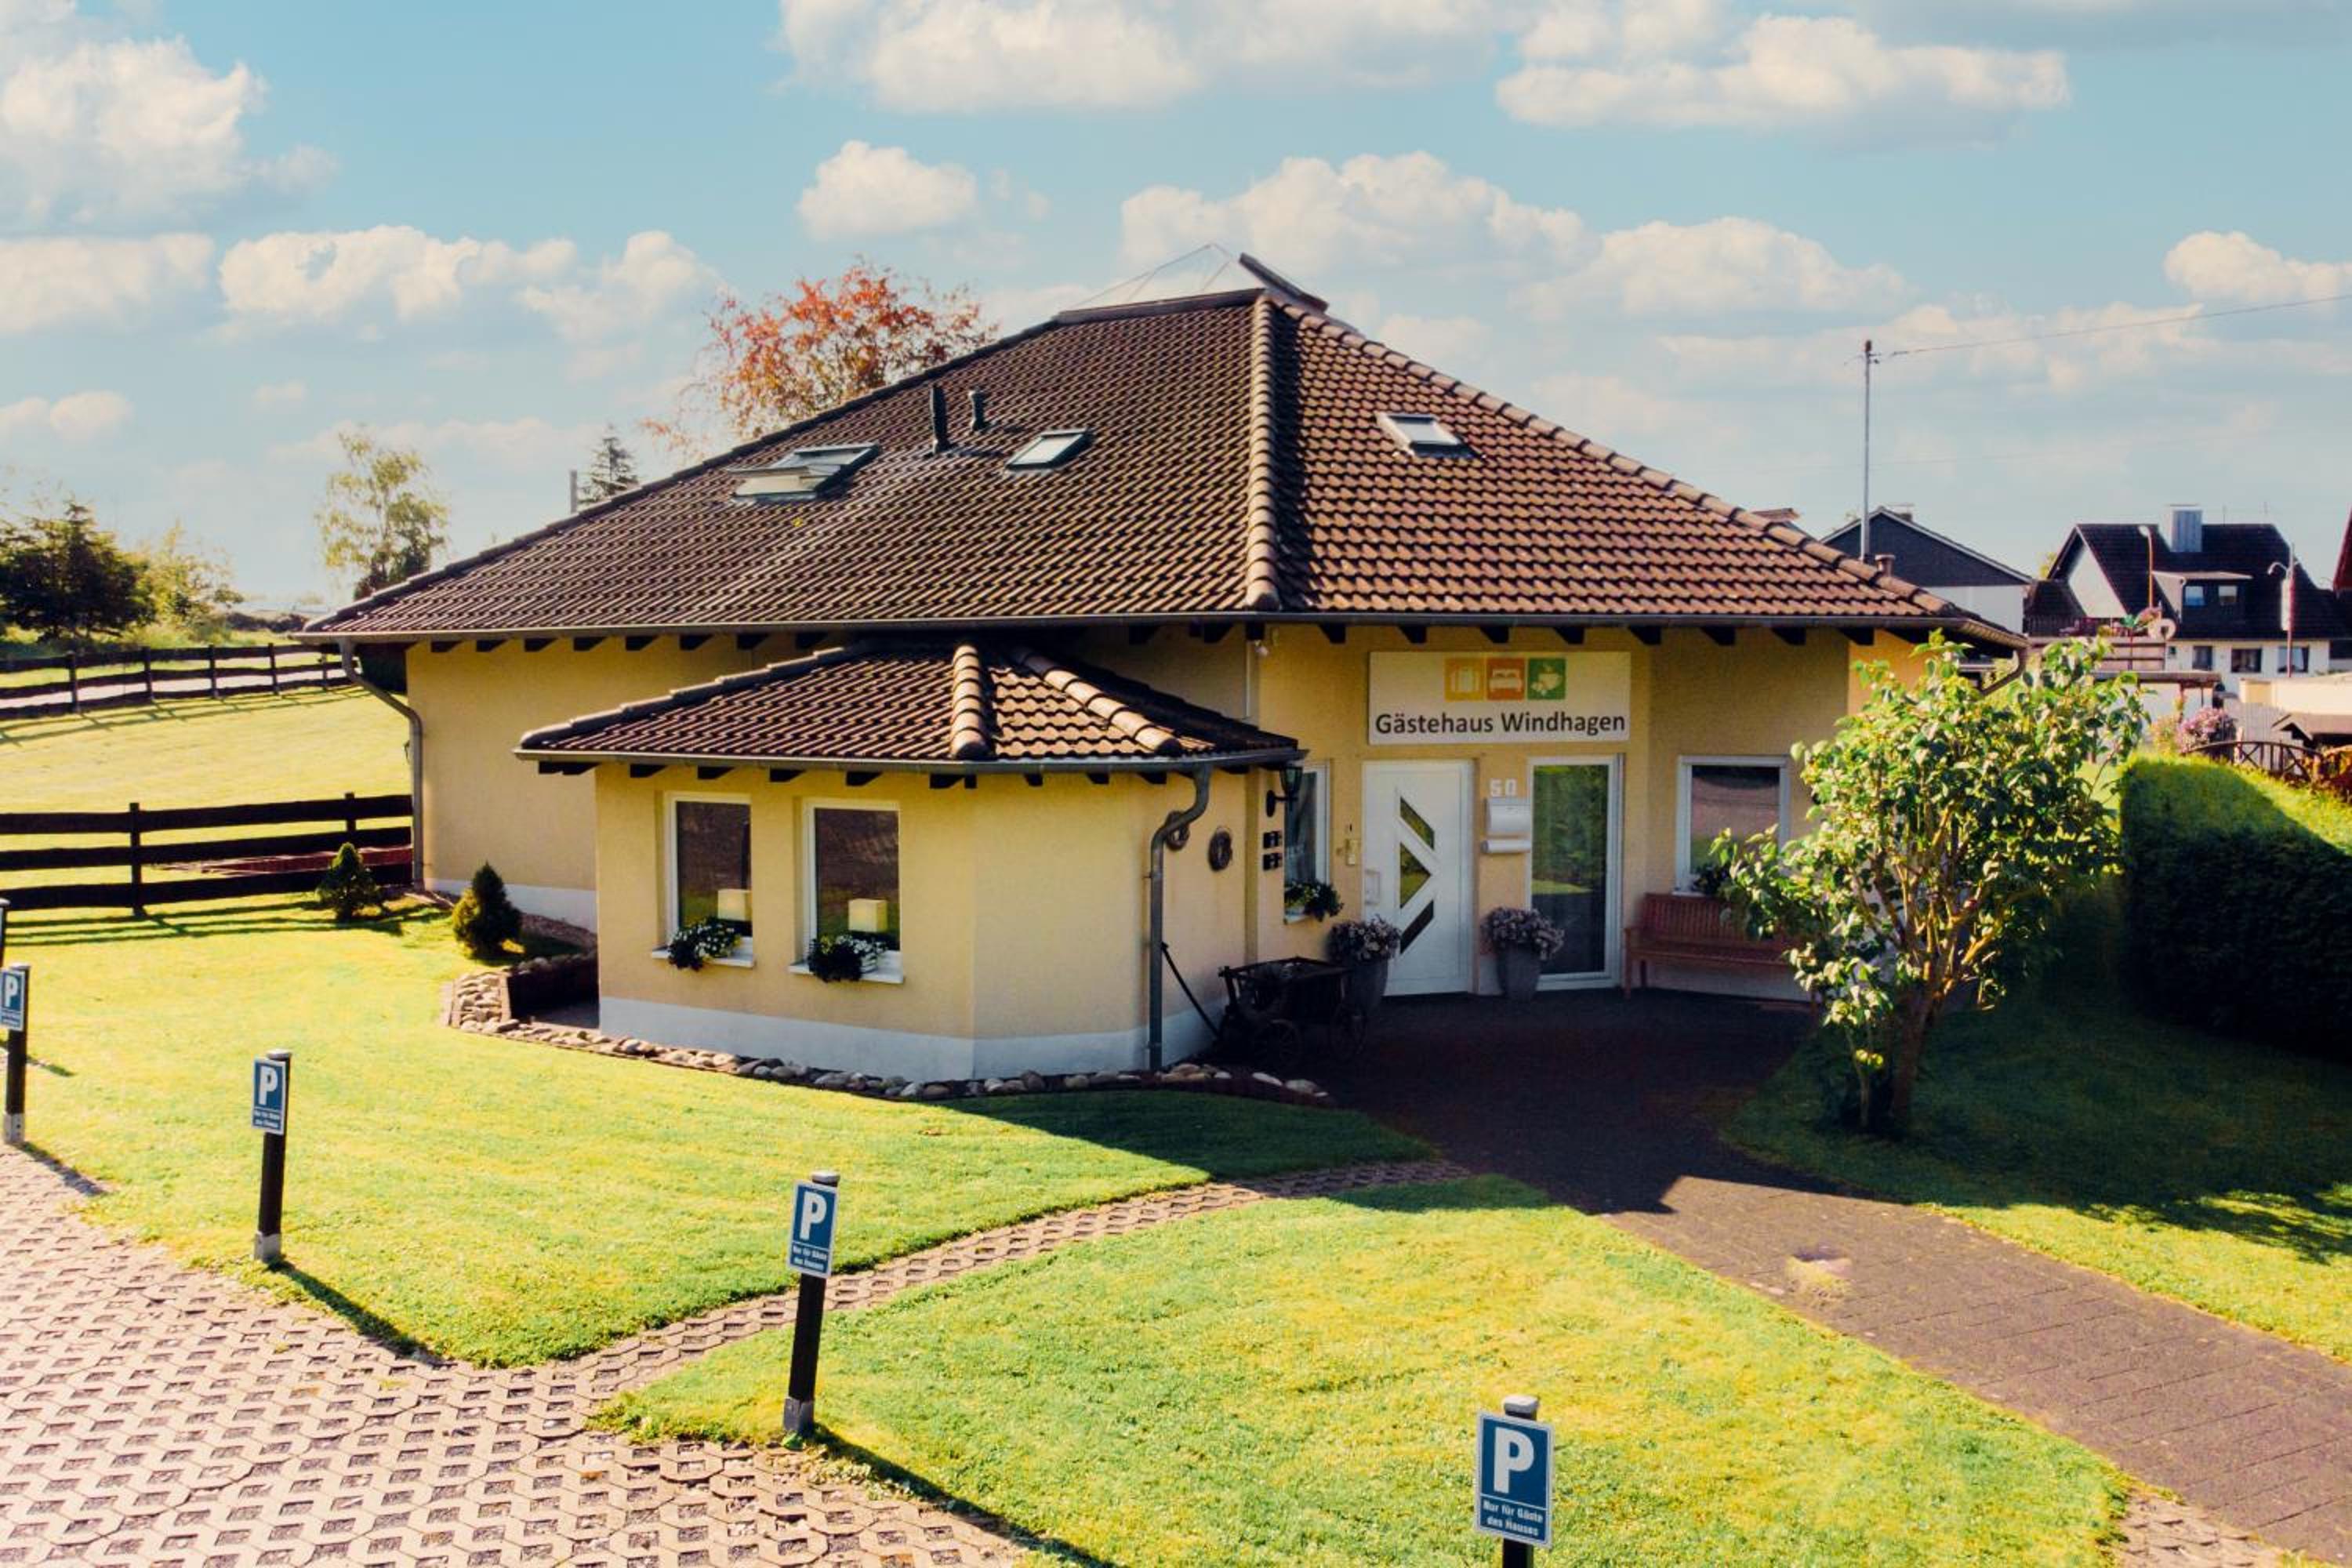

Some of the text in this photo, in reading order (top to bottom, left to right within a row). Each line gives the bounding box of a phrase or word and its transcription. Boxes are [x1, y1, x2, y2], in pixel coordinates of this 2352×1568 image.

[1376, 711, 1626, 735] Gästehaus Windhagen
[5, 975, 18, 1007] P
[259, 1066, 278, 1105] P
[800, 1191, 827, 1240] P
[1494, 1426, 1534, 1494] P
